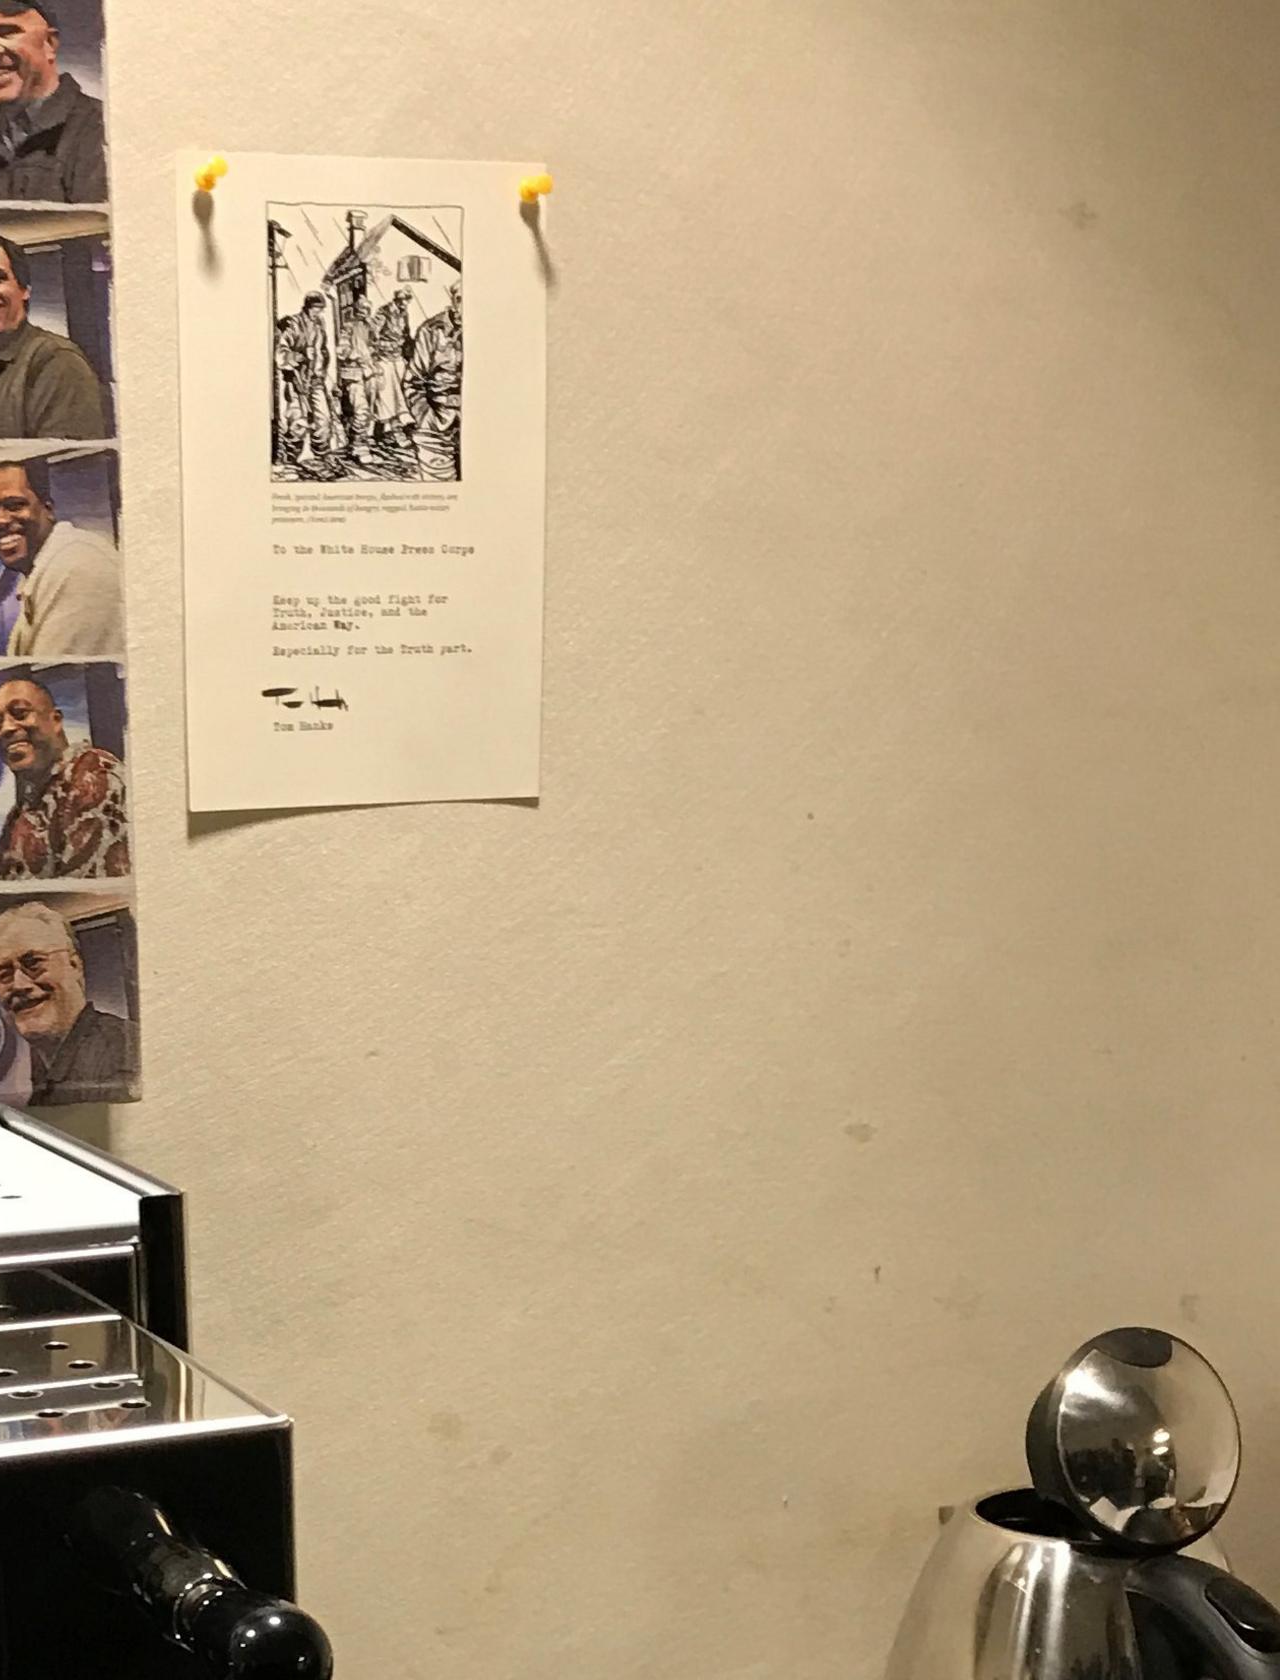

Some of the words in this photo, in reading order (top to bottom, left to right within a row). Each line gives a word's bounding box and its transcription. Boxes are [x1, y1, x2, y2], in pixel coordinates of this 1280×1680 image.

[273, 544, 287, 555] To
[294, 544, 313, 555] the
[320, 544, 354, 555] White
[361, 544, 394, 555] House
[400, 544, 435, 555] Press
[441, 544, 475, 557] Corps
[273, 595, 300, 606] Keep
[306, 597, 320, 607] up
[328, 595, 347, 605] the
[354, 595, 381, 606] good
[388, 594, 421, 606] fight
[428, 594, 448, 605] for
[273, 607, 312, 618] Truth,
[320, 608, 373, 618] Justice,
[381, 607, 401, 617] and
[409, 606, 427, 617] the
[272, 621, 328, 631] American
[333, 620, 360, 632] Way.
[272, 644, 340, 658] Especially
[347, 645, 368, 656] for
[374, 645, 394, 655] the
[400, 644, 434, 655] Truth
[440, 643, 472, 657] part.
[273, 721, 294, 732] Tom
[299, 719, 333, 732] Hanks
